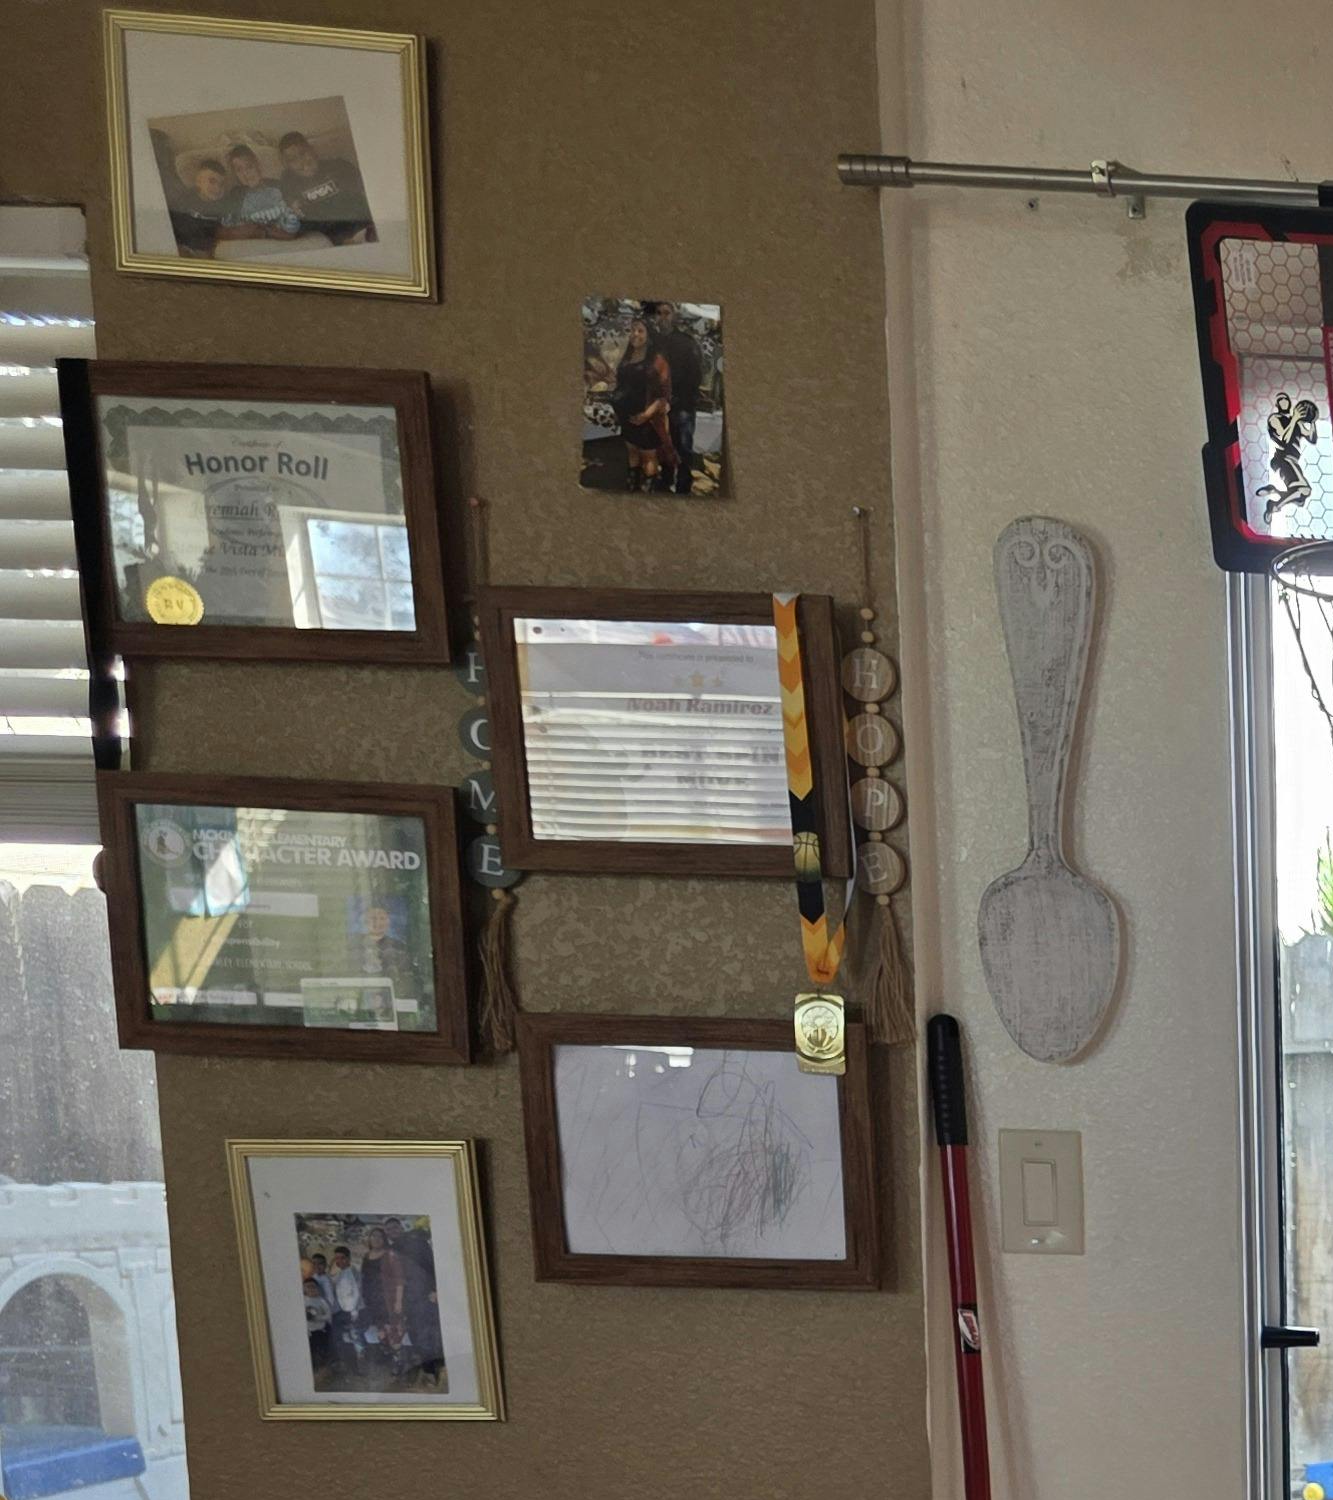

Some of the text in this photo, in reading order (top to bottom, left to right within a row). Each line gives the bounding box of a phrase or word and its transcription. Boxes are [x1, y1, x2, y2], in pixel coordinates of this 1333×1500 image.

[185, 452, 328, 480] Honor Roll
[337, 849, 421, 871] AWARD
